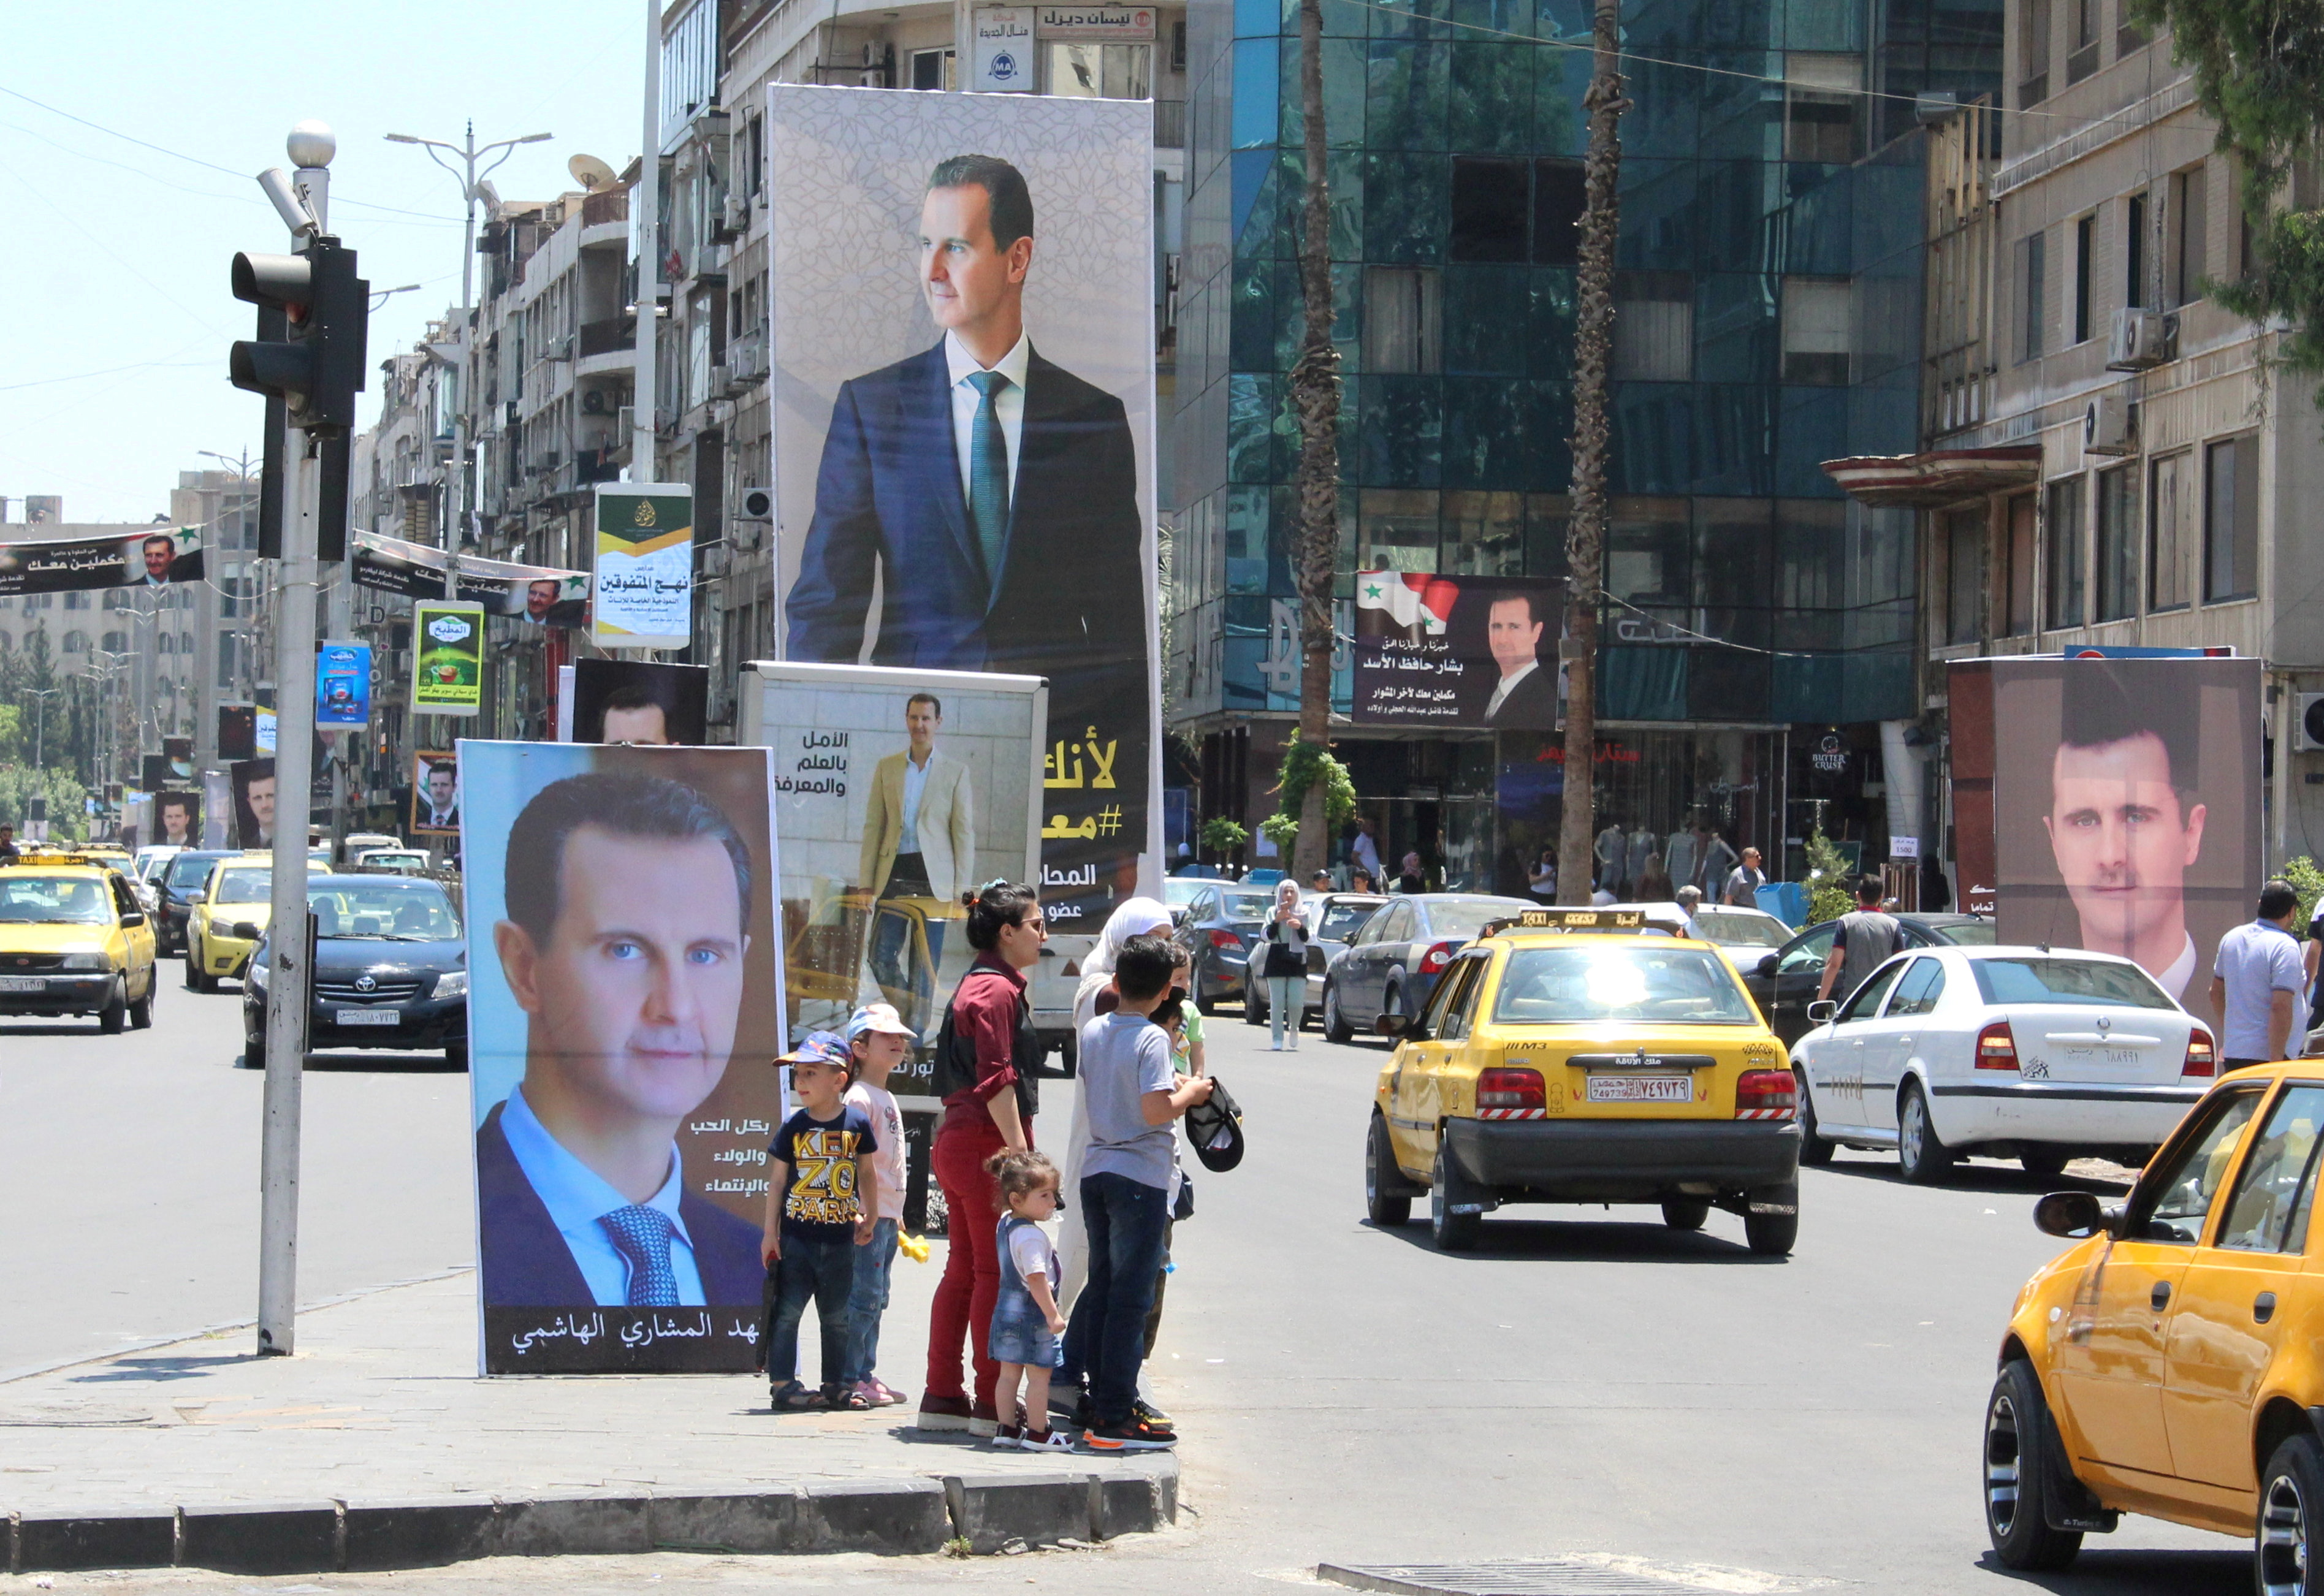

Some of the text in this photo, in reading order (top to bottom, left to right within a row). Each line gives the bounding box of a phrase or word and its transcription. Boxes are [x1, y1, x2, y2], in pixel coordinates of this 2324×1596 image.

[1045, 11, 1130, 26] نيسان ديزل
[980, 25, 1028, 39] منال الجديدة
[995, 63, 1012, 71] MA
[28, 554, 126, 571] مكملين معك
[600, 574, 688, 594] نهج المتفوقين
[1363, 653, 1463, 676] بشار حافظ الأسد
[1372, 686, 1396, 699] المشوار
[1415, 689, 1431, 699] معك
[1432, 690, 1455, 701] مكملين
[1442, 707, 1458, 715] تقدمة
[803, 731, 848, 749] الأمل
[798, 754, 847, 774] بالعلم
[1813, 754, 1846, 764] BUTTER
[1815, 762, 1842, 770] CRUST
[1048, 903, 1082, 922] عضو
[1641, 1081, 1686, 1098] ٧٤٩٧٣٩
[691, 1119, 769, 1135] بكل الحب
[793, 1131, 862, 1160] KEN
[714, 1149, 766, 1166] والولاء
[791, 1158, 855, 1199] ZO
[788, 1198, 859, 1223] PARIS
[512, 1312, 606, 1355] الهاشمي
[620, 1312, 712, 1348] المشاري
